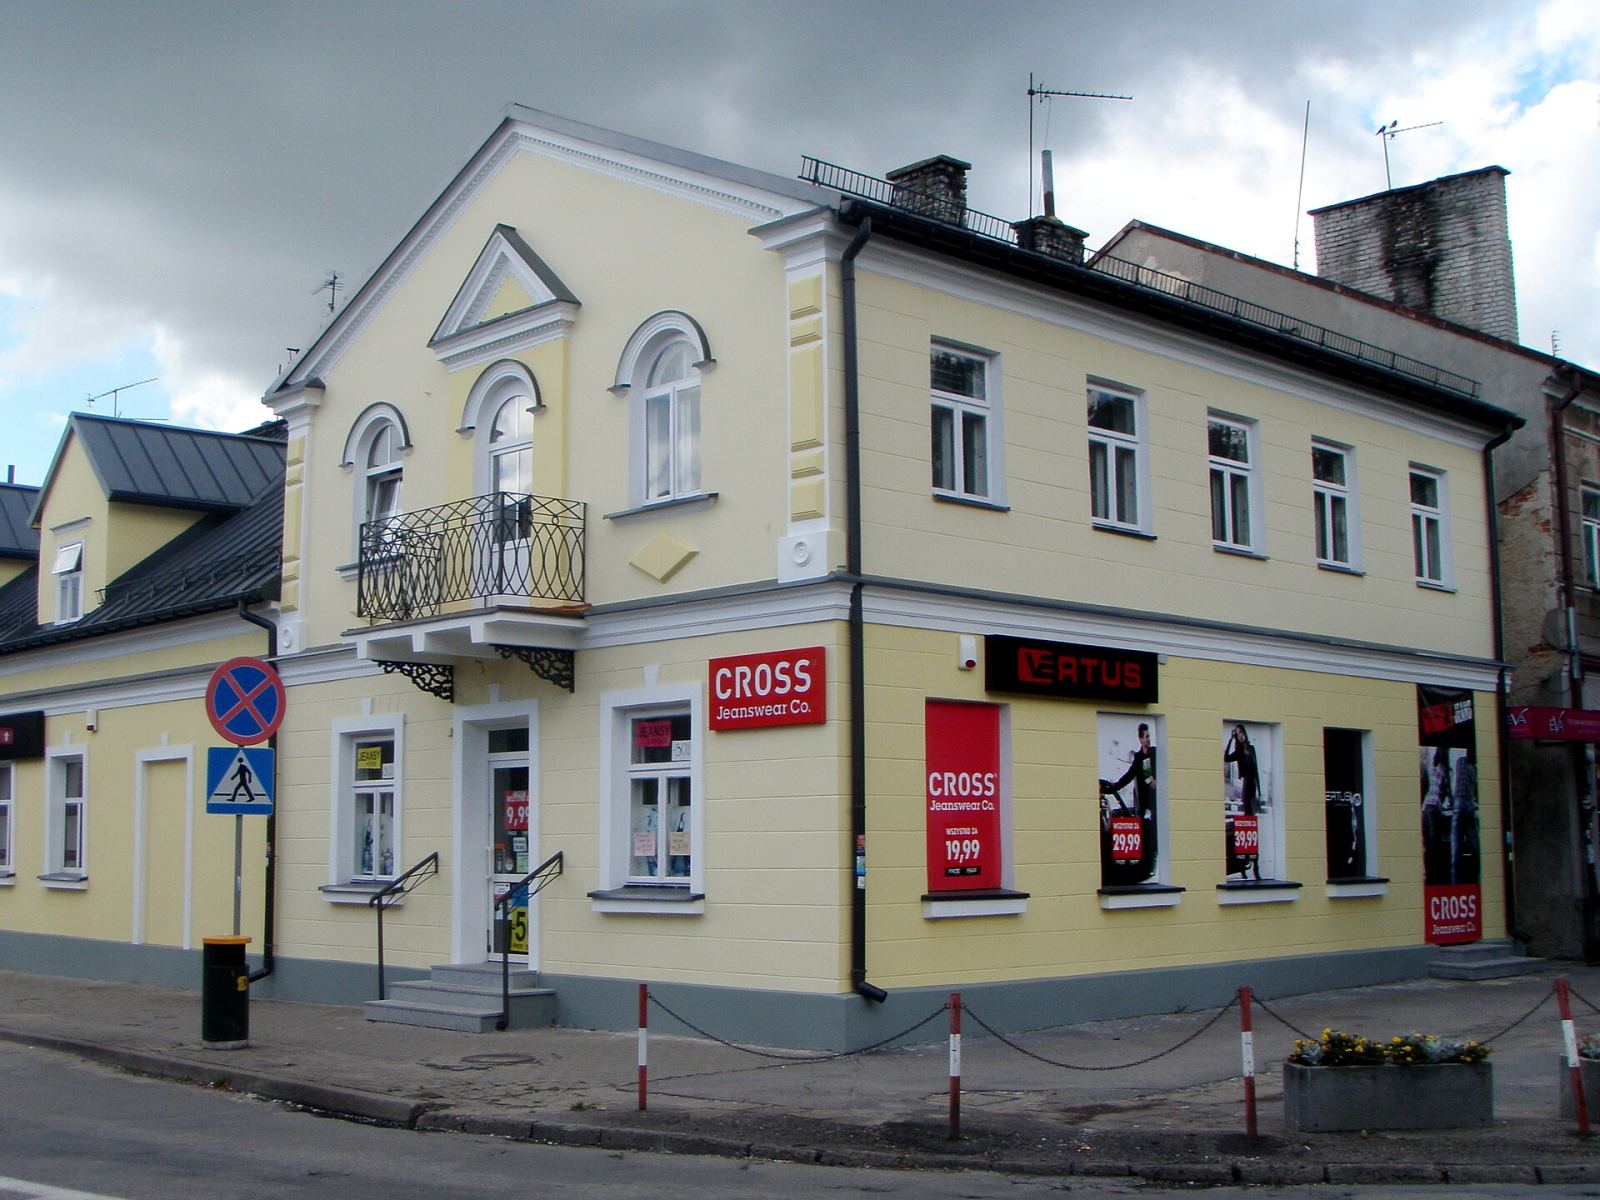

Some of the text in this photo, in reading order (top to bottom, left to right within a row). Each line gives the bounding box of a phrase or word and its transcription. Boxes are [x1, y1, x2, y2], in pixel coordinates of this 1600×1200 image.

[715, 659, 812, 700] CROSS
[716, 699, 811, 720] Jeanswear Co.
[929, 772, 995, 797] CROSS
[930, 800, 995, 811] Jeanswear Co.
[945, 839, 980, 864] 19,99
[1113, 833, 1140, 854] 29,99
[1234, 831, 1257, 849] 39,99
[1431, 895, 1476, 920] CROSS
